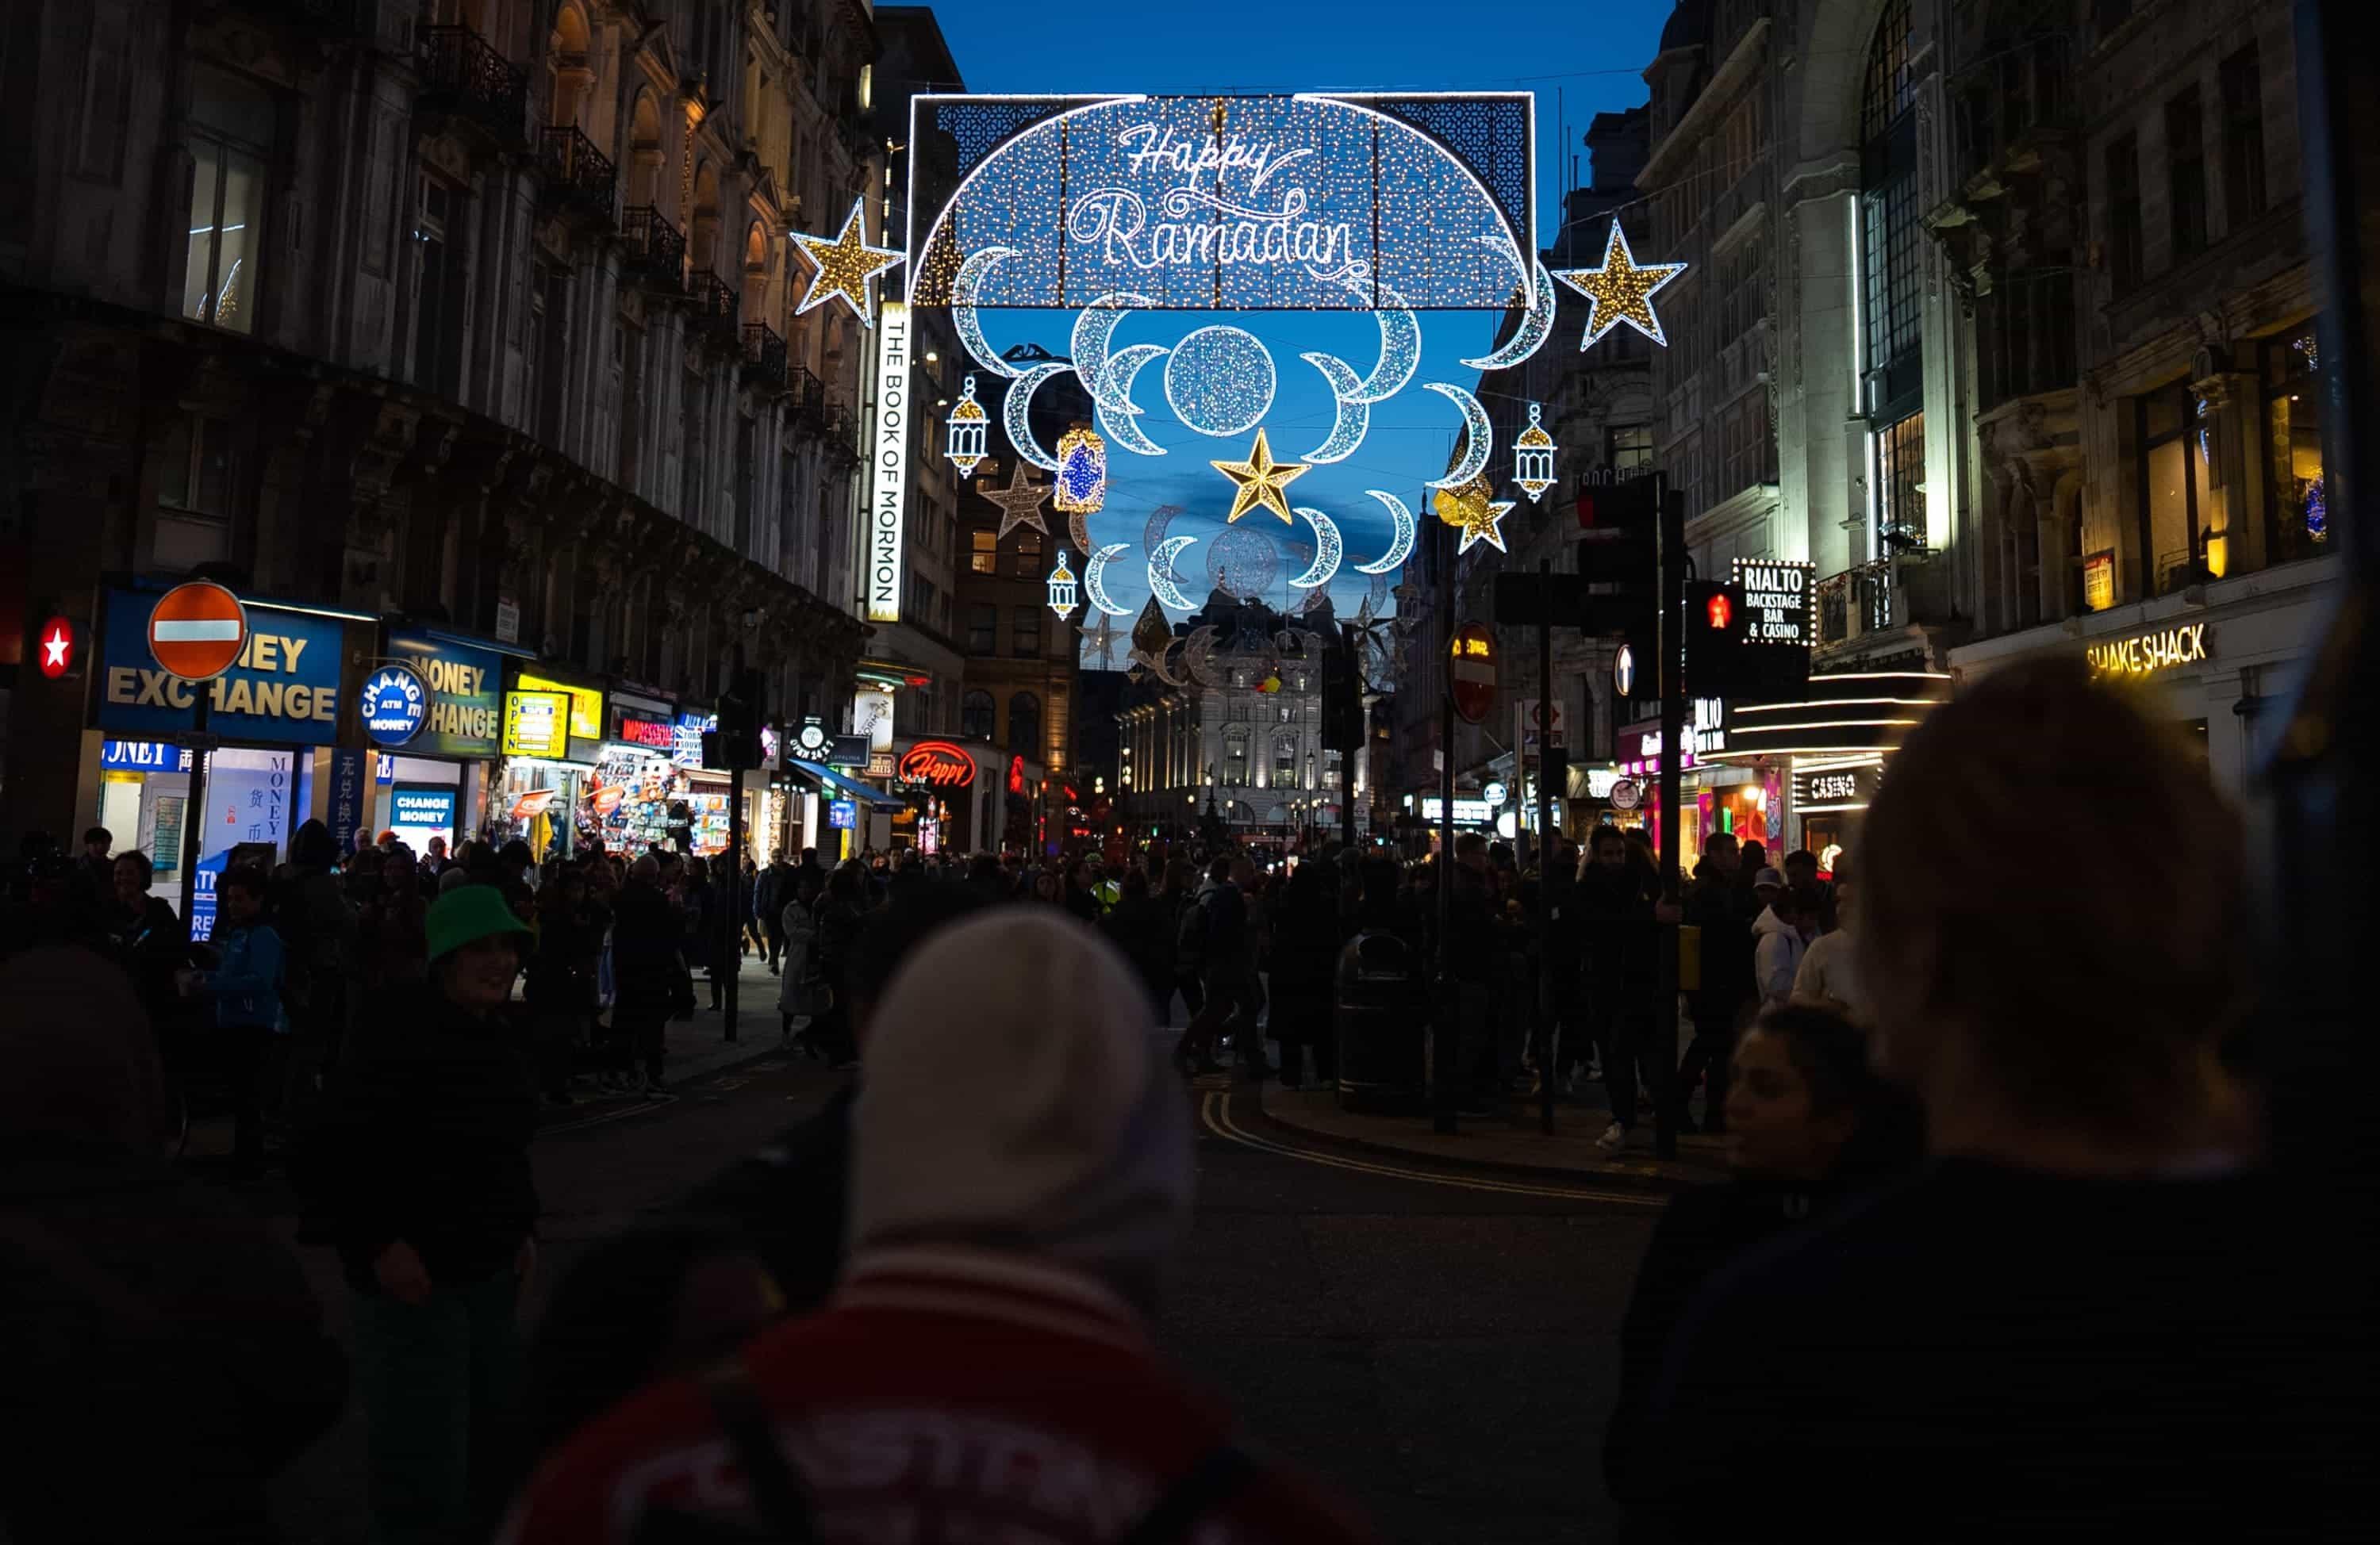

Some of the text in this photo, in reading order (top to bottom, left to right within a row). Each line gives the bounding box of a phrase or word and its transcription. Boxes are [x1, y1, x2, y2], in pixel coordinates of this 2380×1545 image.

[1119, 122, 1314, 197] Happy
[1069, 185, 1371, 282] Ramadan
[875, 322, 905, 602] THE BOOK OF MORMON
[1744, 566, 1803, 592] RIALTO
[1745, 592, 1802, 609] BACKSTAGE
[1763, 608, 1784, 623] BAR
[1749, 623, 1799, 638] & CASINO
[2143, 623, 2206, 670] SHACK
[107, 665, 336, 722] EXCHANGE
[361, 670, 422, 719] CHANGE
[381, 700, 403, 710] ATM
[369, 719, 414, 731] MONEY
[508, 696, 520, 749] OPEN
[908, 752, 968, 787] Happy
[269, 757, 286, 835] MONEY
[1811, 774, 1856, 799] CASINO
[397, 796, 450, 809] CHANGE
[399, 811, 446, 823] MONEY
